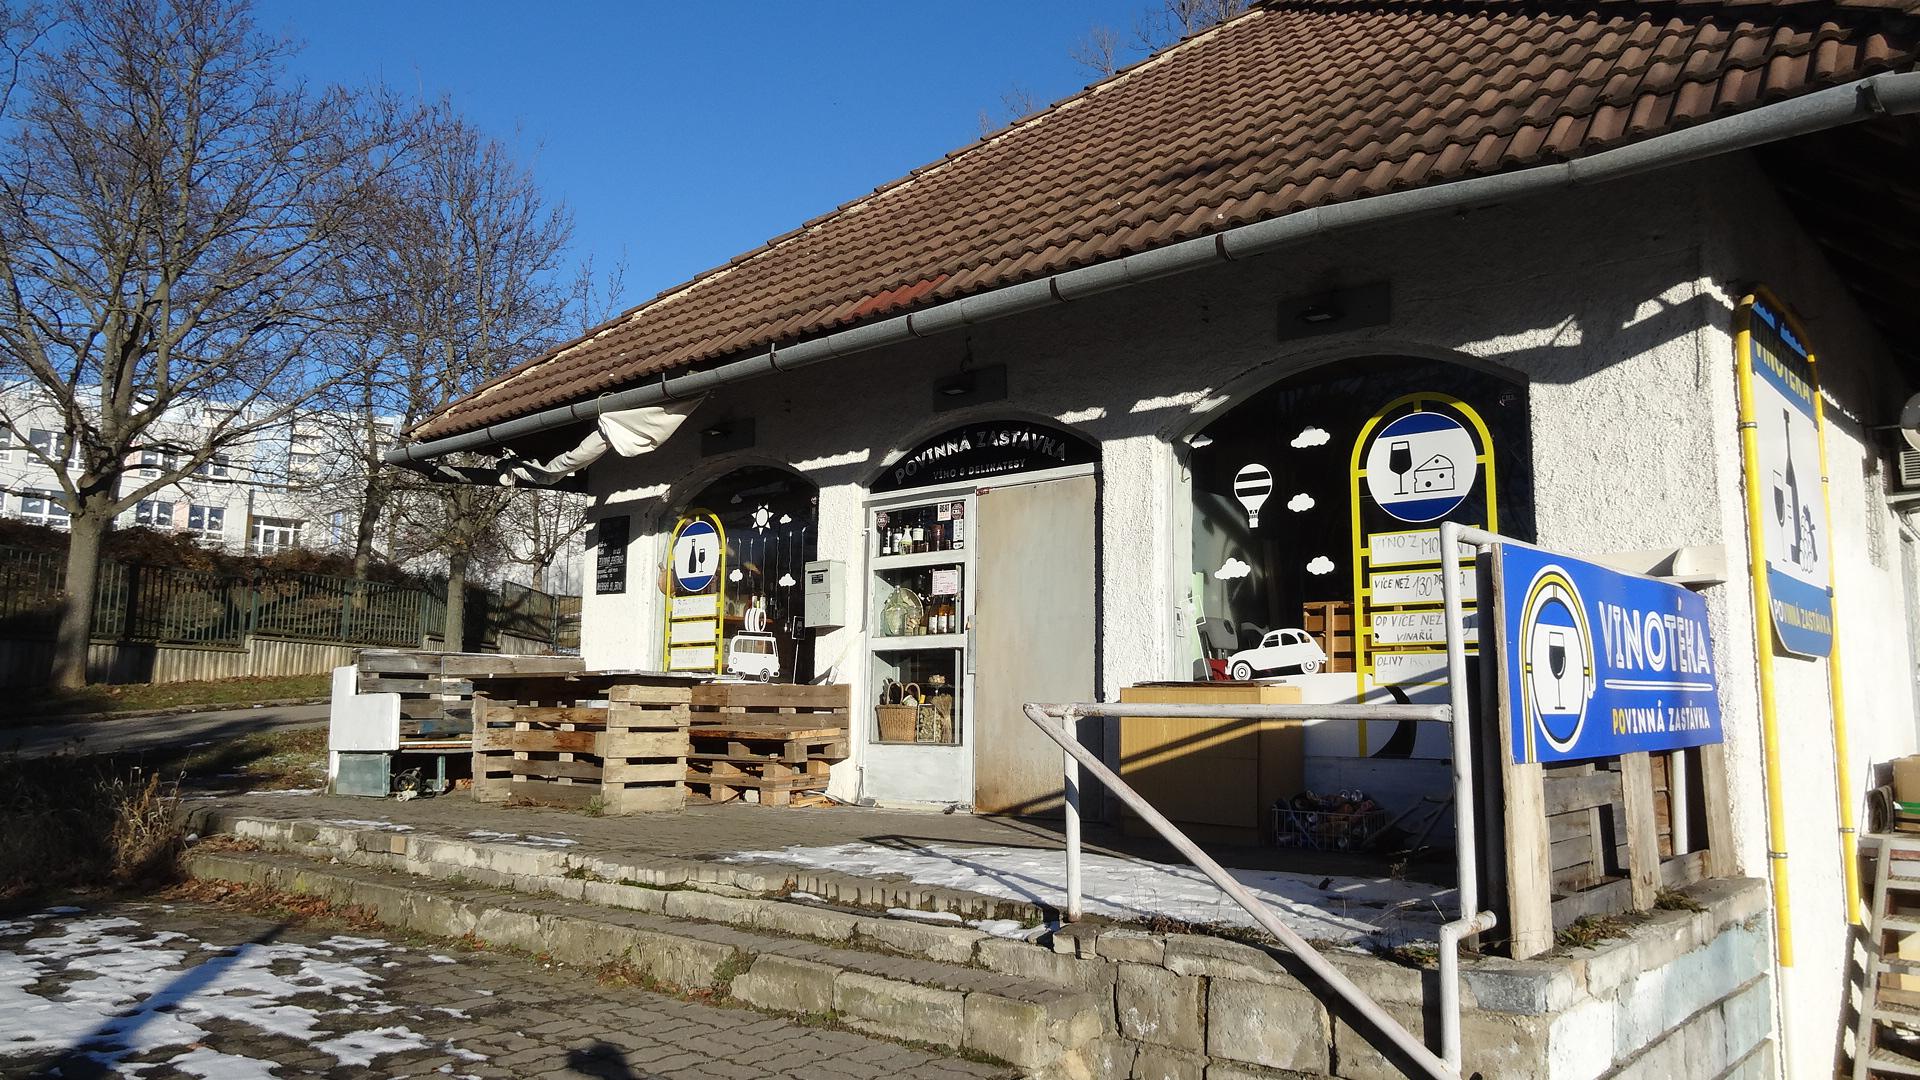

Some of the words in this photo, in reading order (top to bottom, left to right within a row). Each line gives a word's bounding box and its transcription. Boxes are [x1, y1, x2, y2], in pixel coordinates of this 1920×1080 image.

[894, 430, 971, 485] POVINNÁ
[975, 427, 1066, 462] ZASTÁVKA
[968, 459, 1027, 476] DELIKATESY
[1408, 535, 1417, 548] Z
[1374, 577, 1392, 589] VÍCE
[1394, 575, 1411, 589] NEŽ
[1412, 575, 1433, 597] 130
[1598, 596, 1711, 675] VINOTÉKA
[1376, 655, 1404, 667] OLIVY
[1612, 699, 1666, 736] POVINNÁ
[1667, 700, 1711, 732] ZASTÁVKA
